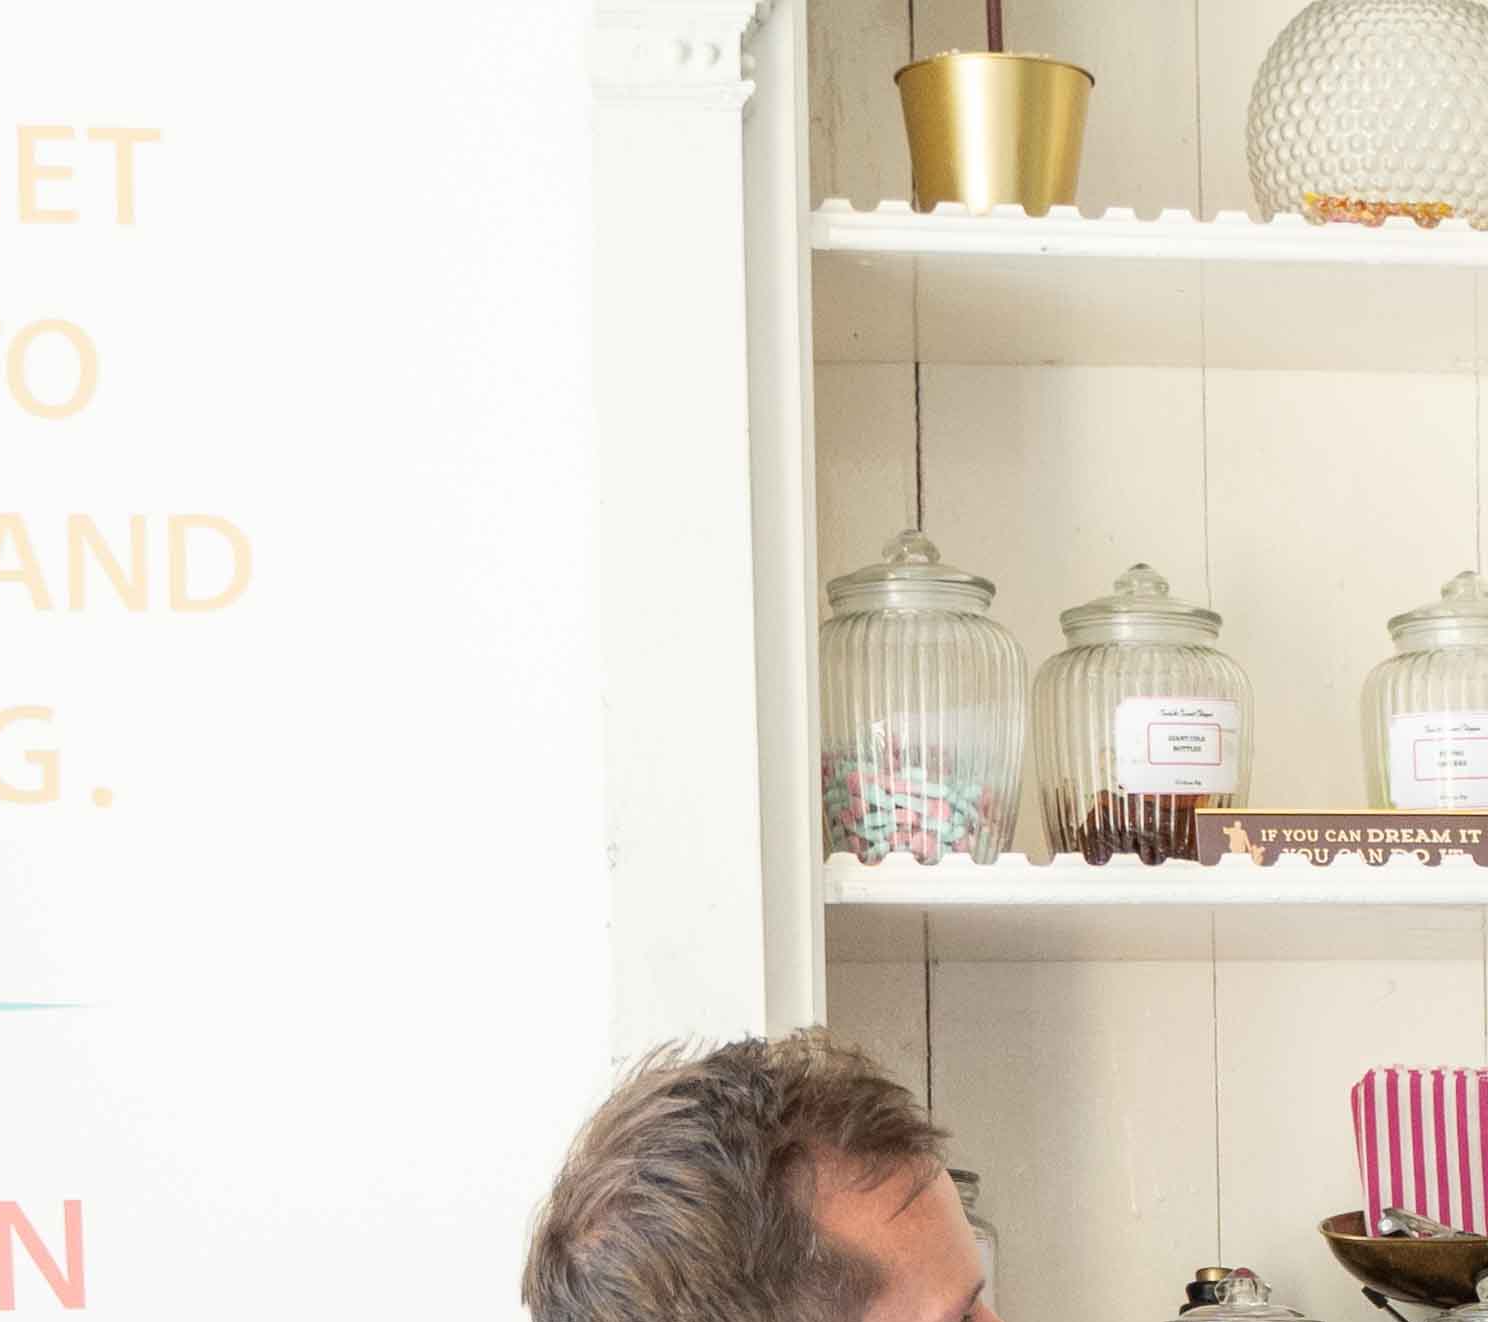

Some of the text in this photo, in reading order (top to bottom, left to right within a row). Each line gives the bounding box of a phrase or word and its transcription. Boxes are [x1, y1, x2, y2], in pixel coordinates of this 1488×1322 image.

[1261, 828, 1483, 844] IF YOU CAN DREAM IT
